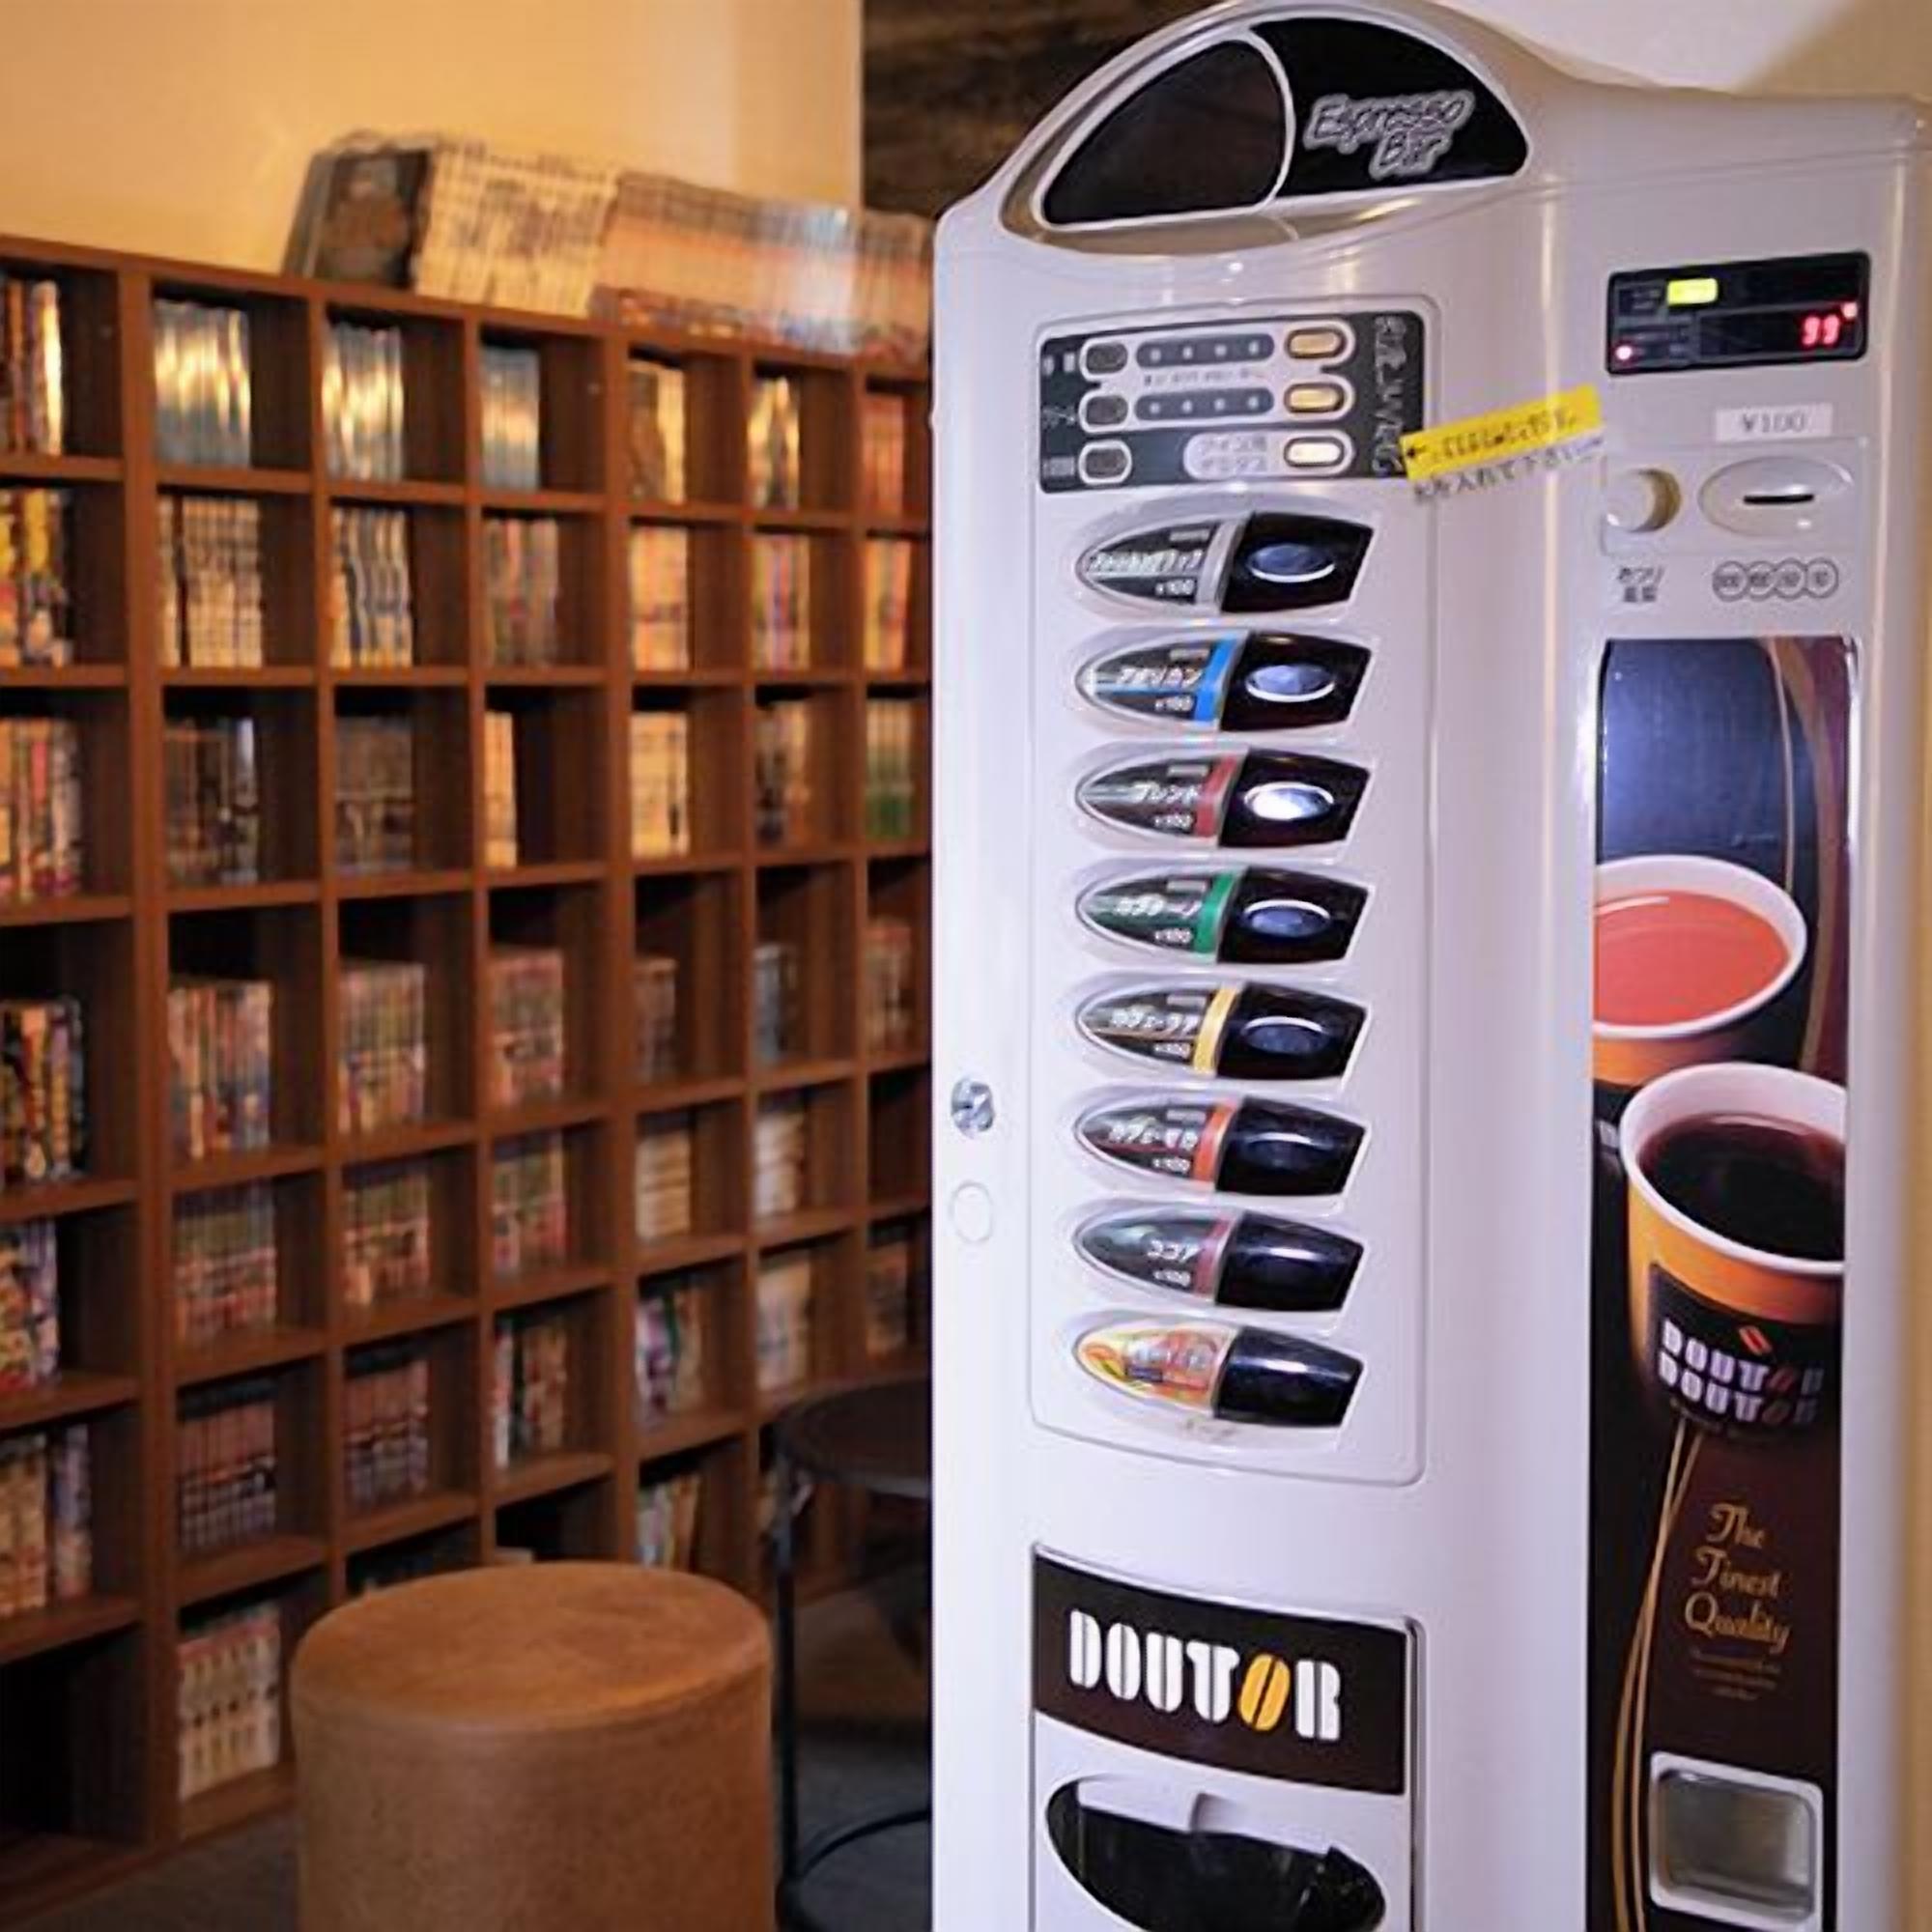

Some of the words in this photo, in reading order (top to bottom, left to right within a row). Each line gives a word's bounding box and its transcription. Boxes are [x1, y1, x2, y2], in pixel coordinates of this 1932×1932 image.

[1742, 411, 1805, 434] ¥100
[1705, 1502, 1765, 1549] The
[1685, 1592, 1791, 1654] Quality
[1069, 1607, 1342, 1742] DOUTOR
